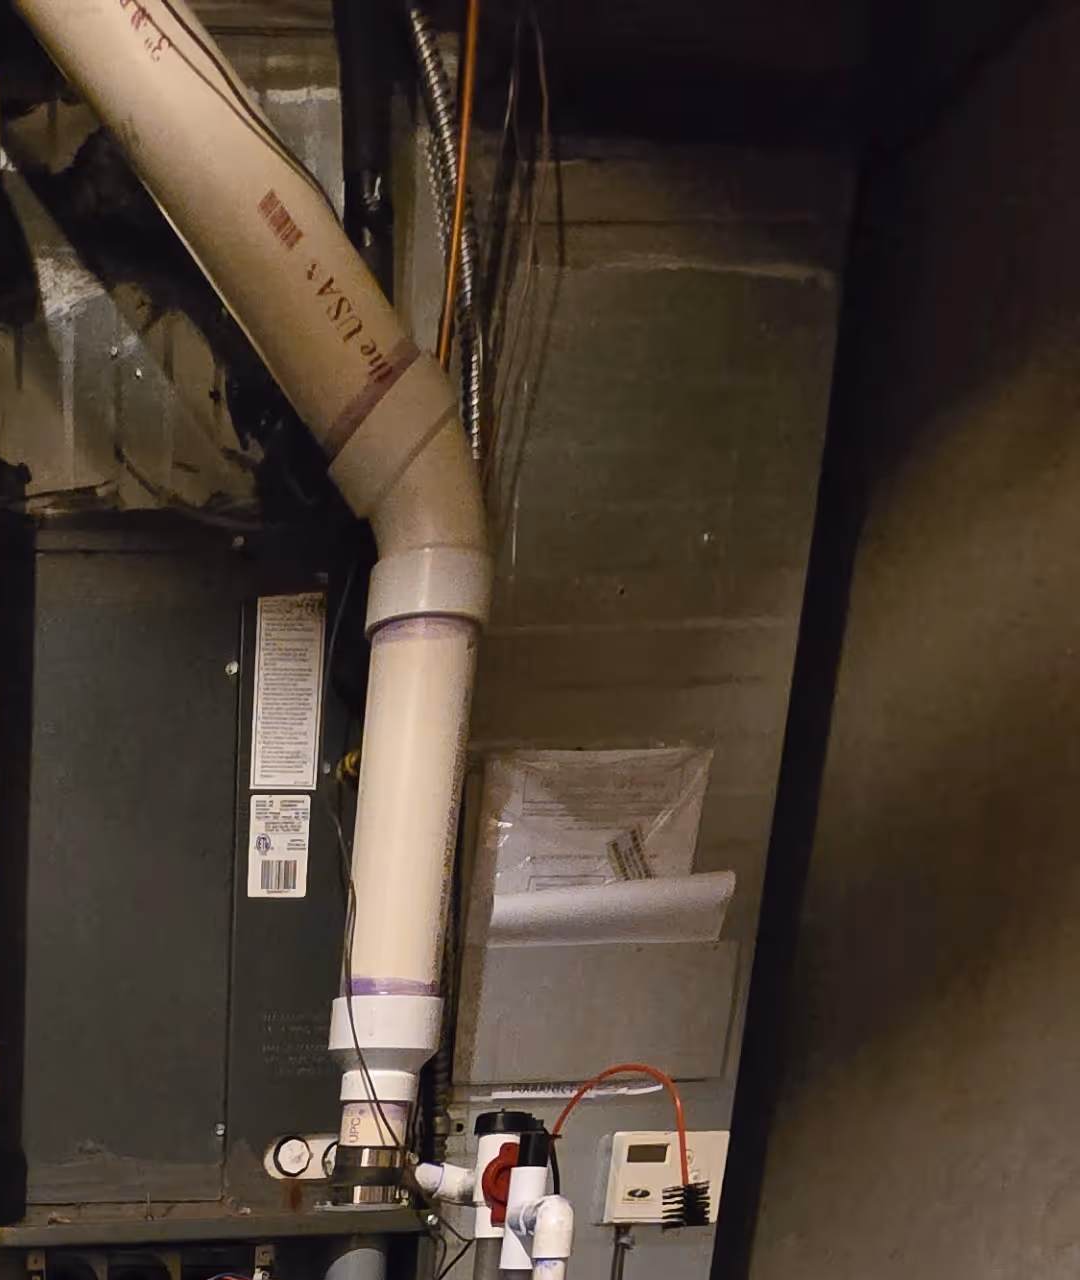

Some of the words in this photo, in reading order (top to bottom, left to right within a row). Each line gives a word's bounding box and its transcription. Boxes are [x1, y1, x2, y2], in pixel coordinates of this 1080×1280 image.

[315, 275, 363, 344] USA
[359, 338, 394, 383] the
[349, 1117, 361, 1143] UPC
